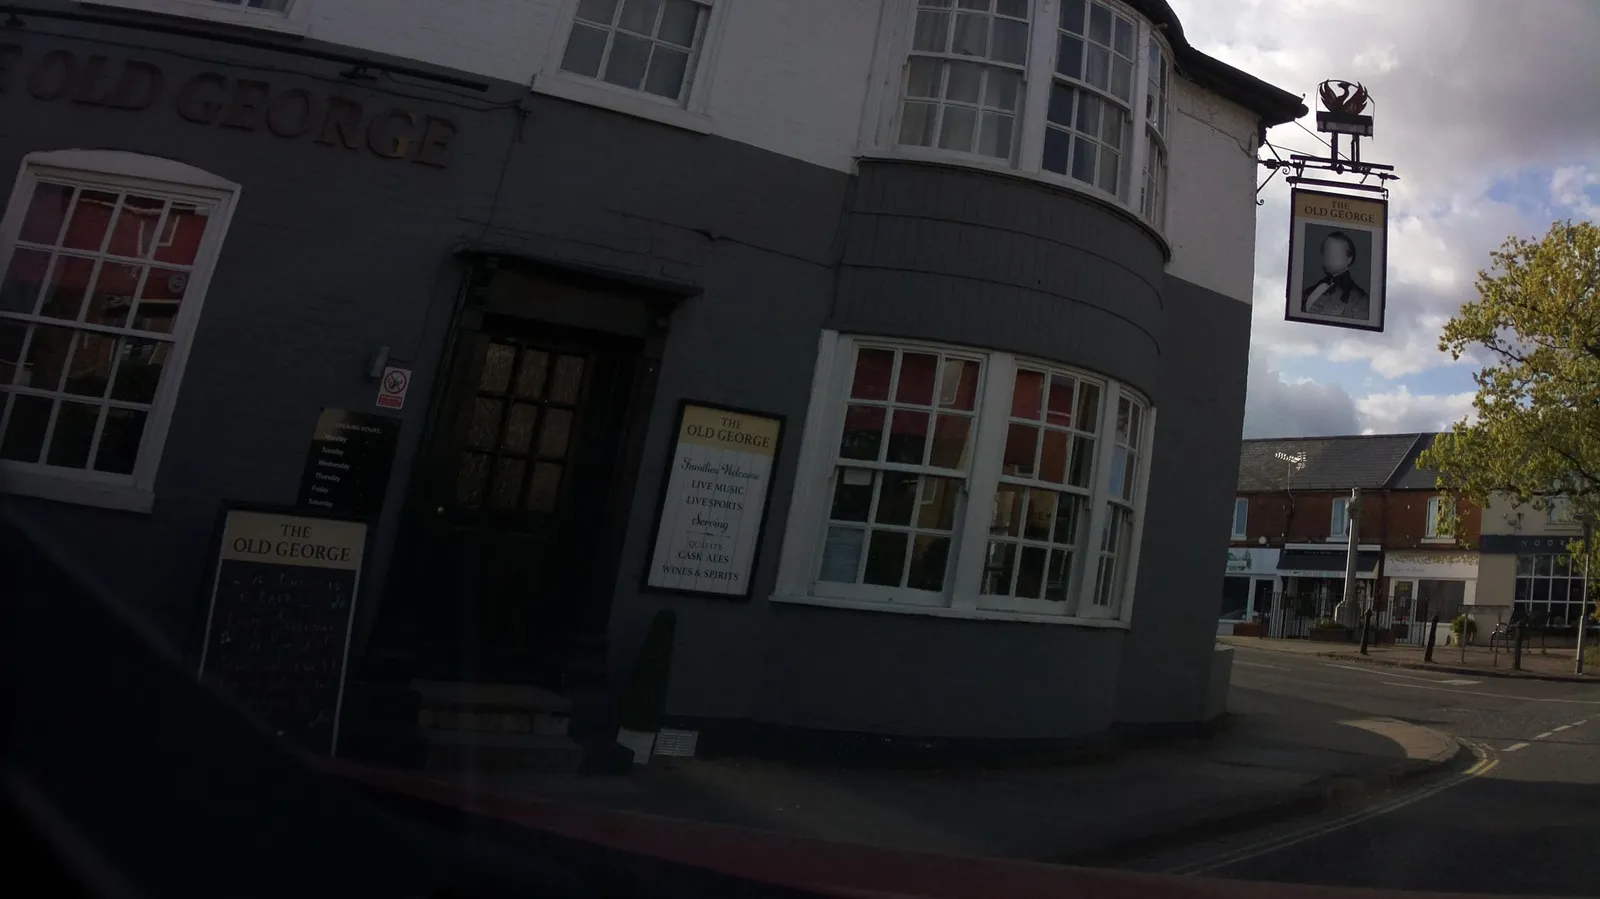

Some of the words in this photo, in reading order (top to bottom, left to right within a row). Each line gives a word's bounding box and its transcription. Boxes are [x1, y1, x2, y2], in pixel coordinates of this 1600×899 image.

[27, 49, 165, 112] OLD
[176, 71, 458, 169] GEORGE
[1332, 200, 1350, 210] THE
[1304, 205, 1328, 217] OLD
[1330, 209, 1375, 223] GEORGE
[721, 416, 743, 429] THE
[687, 425, 715, 438] OLD
[717, 430, 770, 449] GEORGE
[321, 446, 345, 457] Tuesday
[318, 460, 351, 471] Wednesday
[681, 457, 719, 476] Families
[721, 463, 760, 480] Welcome
[315, 472, 342, 483] Thursday
[311, 484, 329, 494] Friday
[691, 480, 713, 491] LIVE
[715, 484, 745, 495] MUSIC
[308, 498, 335, 508] Saturday
[686, 496, 707, 507] LIVE
[708, 499, 744, 511] SPORTS
[692, 512, 729, 533] Serving
[280, 523, 312, 538] THE
[233, 537, 272, 555] OLD
[275, 541, 351, 562] GEORGE
[688, 540, 724, 551] QUALITY
[678, 551, 702, 562] CASK
[706, 553, 730, 564] ALES
[662, 565, 693, 577] WINES
[703, 569, 740, 582] SPIRITS
